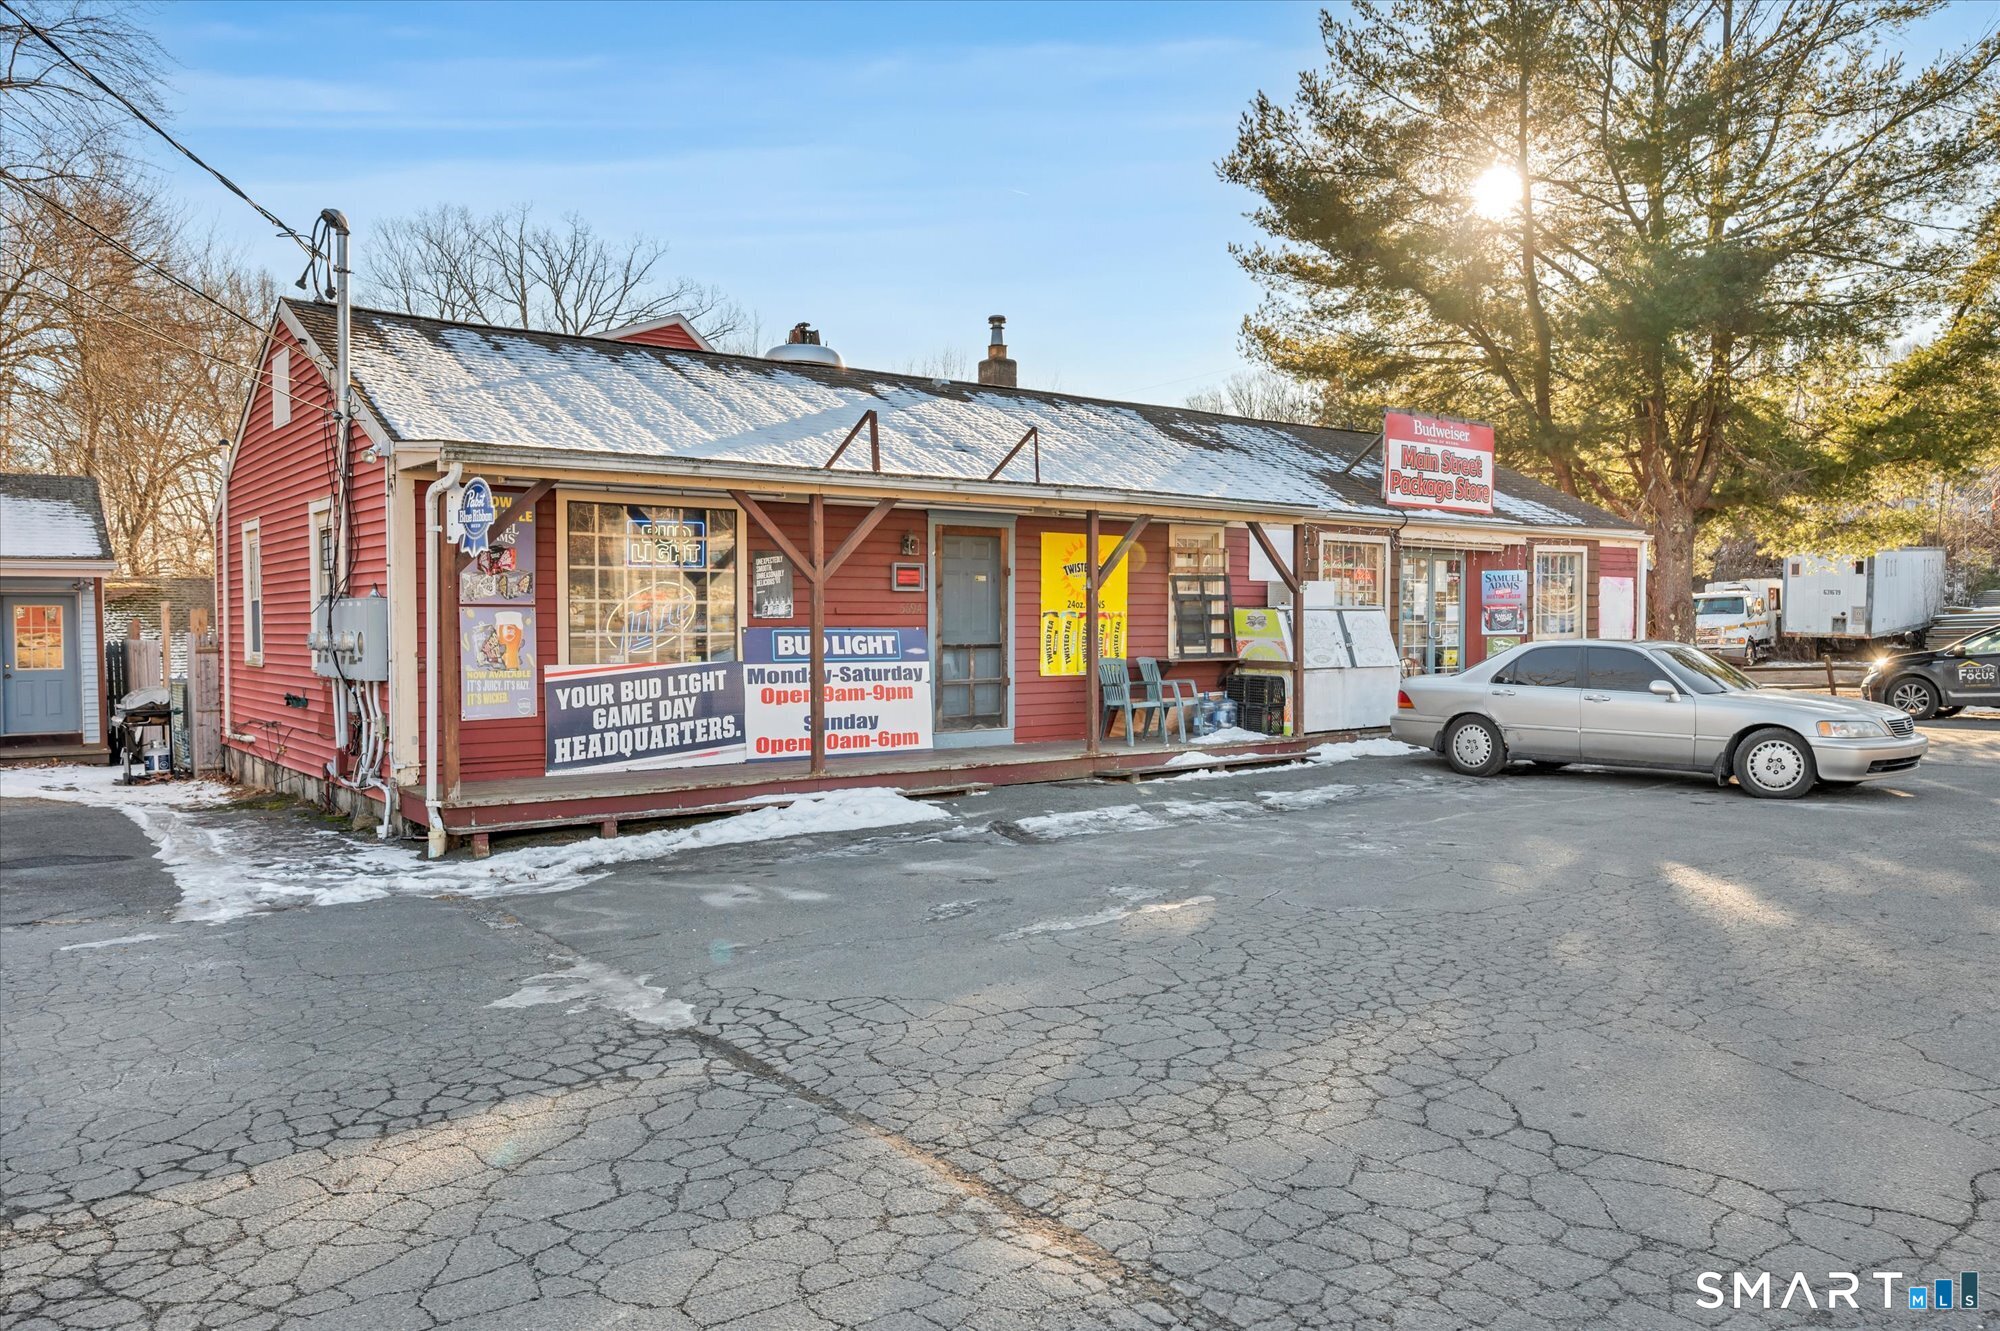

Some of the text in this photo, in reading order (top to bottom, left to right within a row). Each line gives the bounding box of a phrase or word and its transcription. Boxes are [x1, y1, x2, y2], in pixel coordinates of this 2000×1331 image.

[1413, 419, 1470, 442] Budweiser
[1401, 444, 1483, 478] Main Street
[1390, 469, 1490, 503] Package Store
[466, 489, 486, 508] Pabst
[459, 510, 472, 522] Blue
[473, 508, 493, 522] Ribbon
[641, 524, 692, 544] BUD
[631, 543, 702, 563] LIGHT
[1063, 563, 1087, 575] TWISTE
[1485, 573, 1523, 584] SAMUEL
[1488, 582, 1520, 591] ADAMS
[1067, 600, 1086, 609] 24oz.
[1046, 634, 1054, 665] TWISTED
[466, 670, 532, 679] NOW AVAILABLE
[467, 680, 481, 692] IT'S
[556, 682, 615, 711] YOUR
[620, 677, 662, 703] BUD
[667, 670, 727, 697] LIGHT
[823, 684, 914, 702] 9am-9pm
[592, 696, 697, 730] GAME DAY
[554, 715, 742, 764] HEADQUARTERS.
[756, 736, 812, 754] Open
